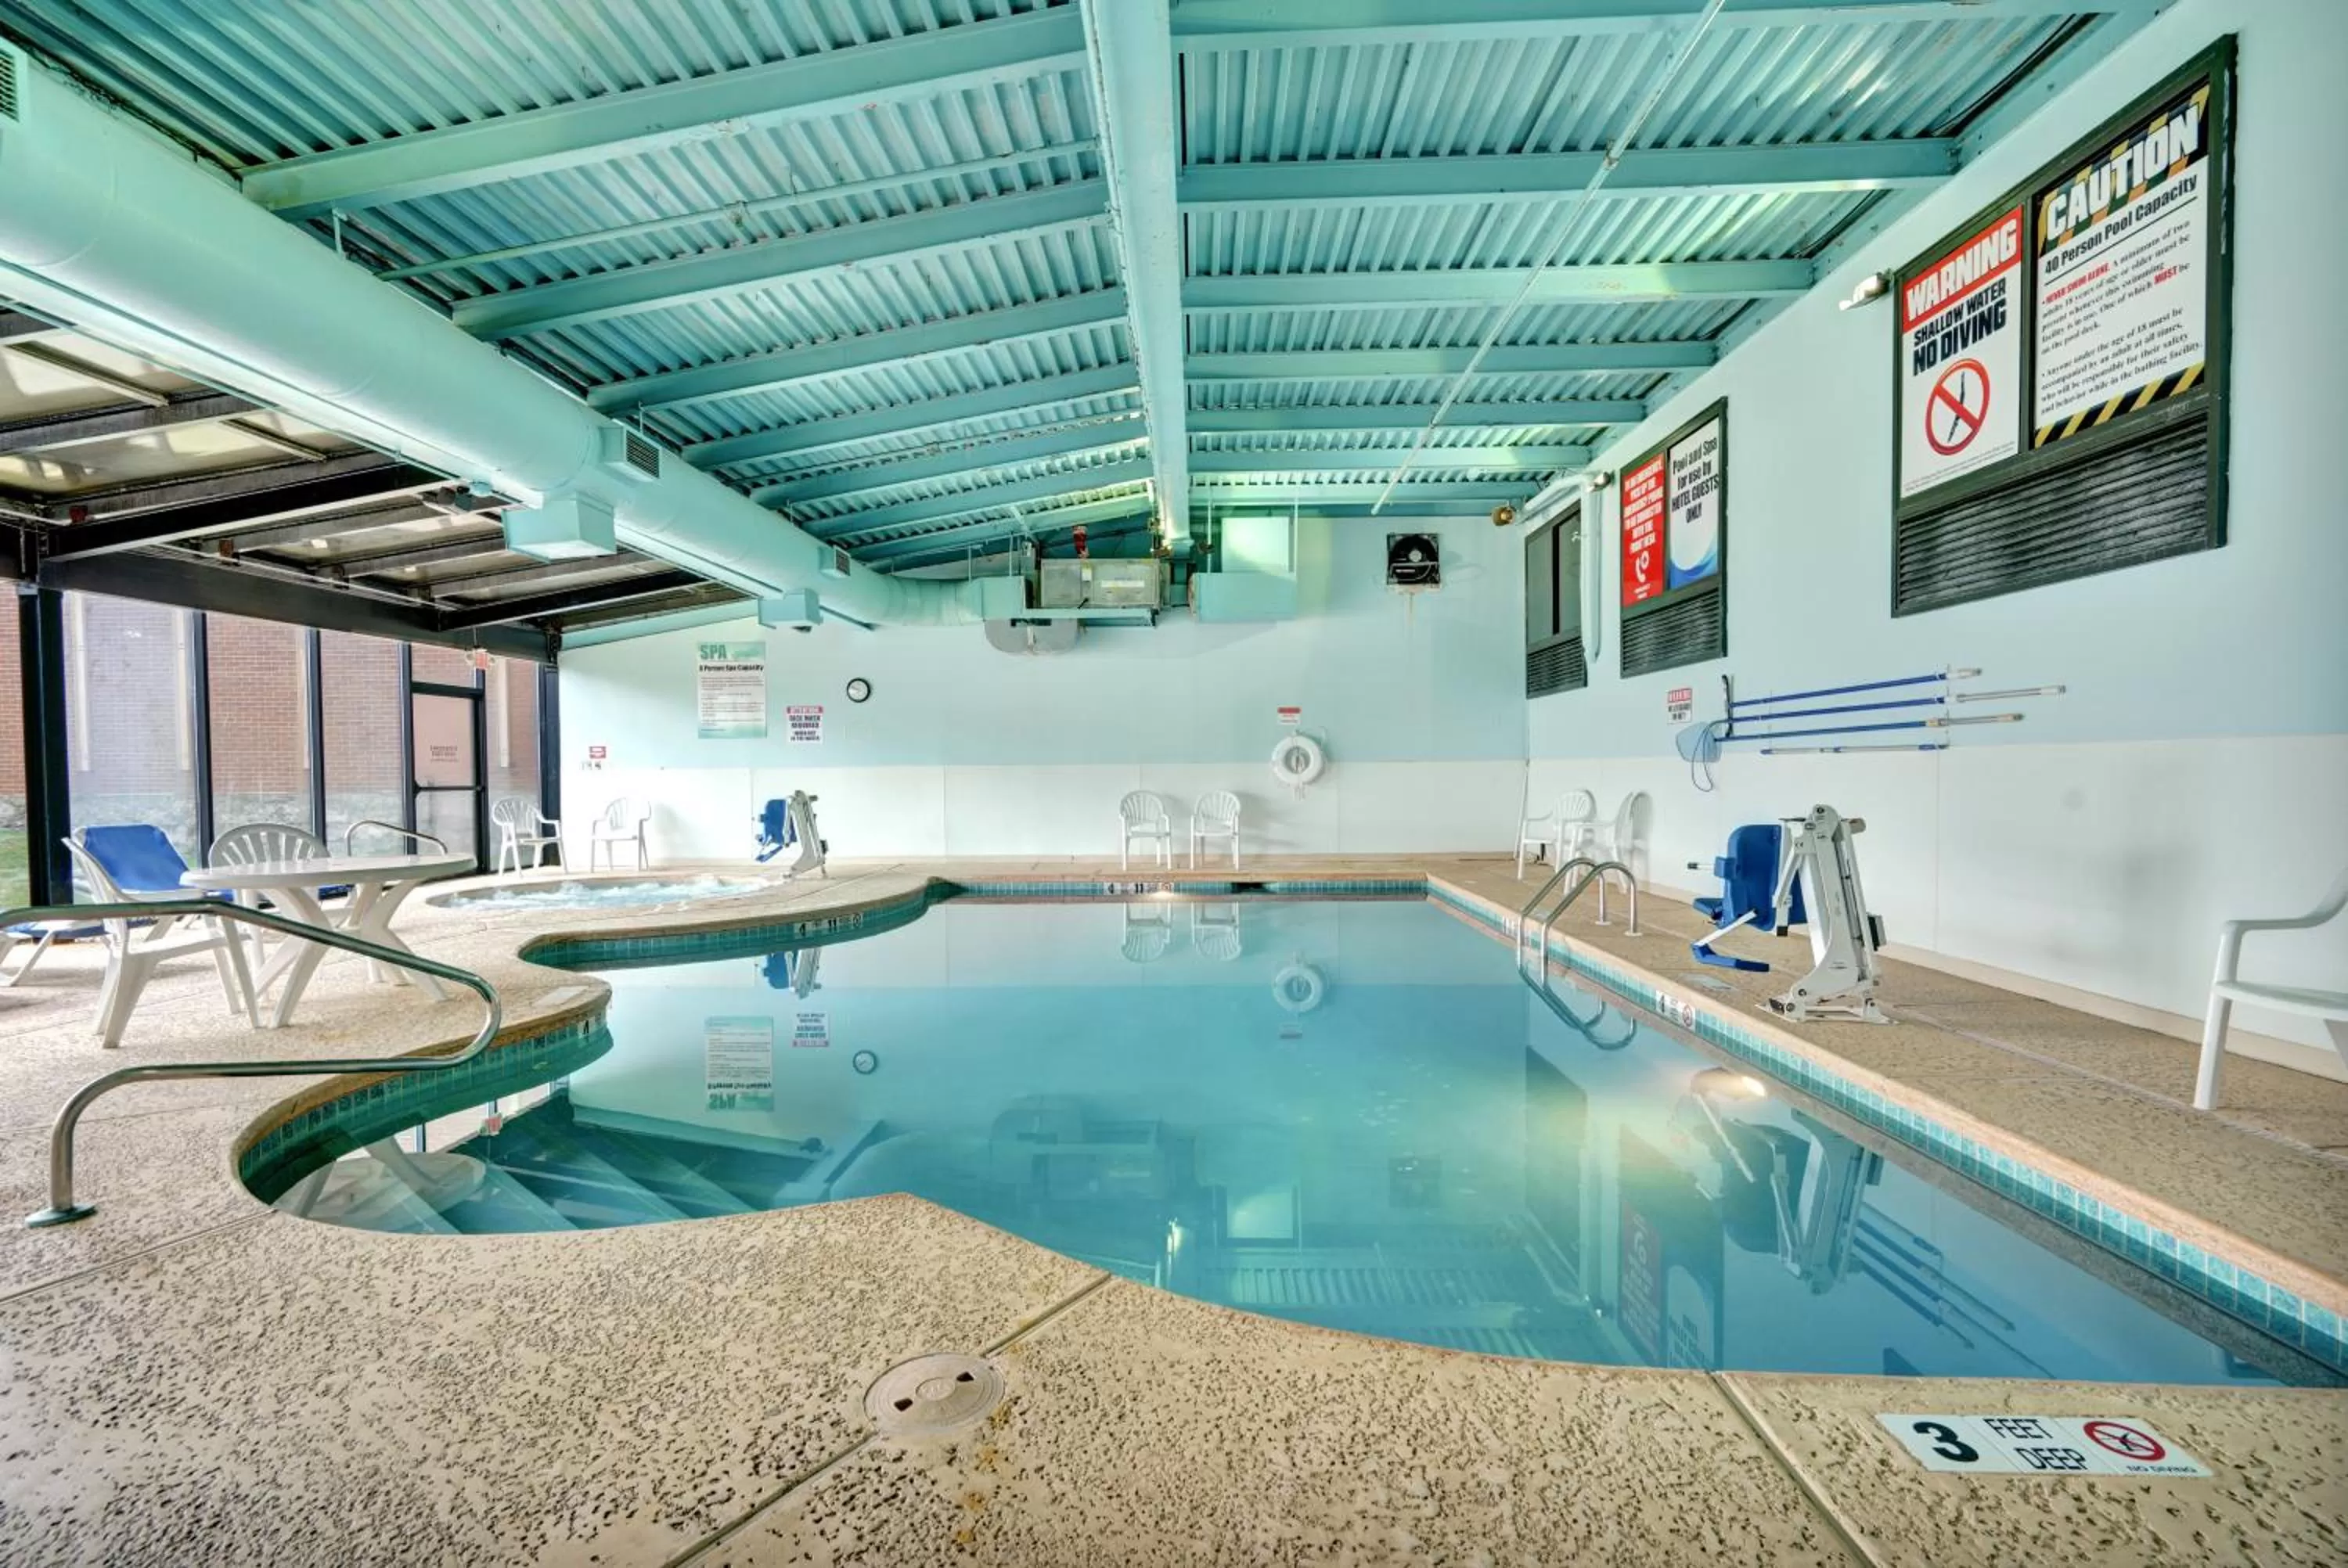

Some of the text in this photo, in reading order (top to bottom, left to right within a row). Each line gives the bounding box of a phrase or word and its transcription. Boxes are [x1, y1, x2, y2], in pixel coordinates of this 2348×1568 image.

[2047, 105, 2199, 240] CAUTION
[2045, 174, 2198, 273] 40 Person Pool Capacity
[1906, 218, 2017, 322] WARNING
[1914, 277, 2006, 347] SHALLOW WATER
[1914, 298, 2006, 376] NO DIVING
[1689, 448, 1702, 467] and
[1703, 437, 1717, 455] Spa
[1672, 492, 1691, 512] HOTEL
[1692, 473, 1719, 502] GUESTS
[700, 645, 726, 660] SPA
[1913, 1419, 2053, 1462] 3 FEET
[2015, 1448, 2088, 1469] DEEP
